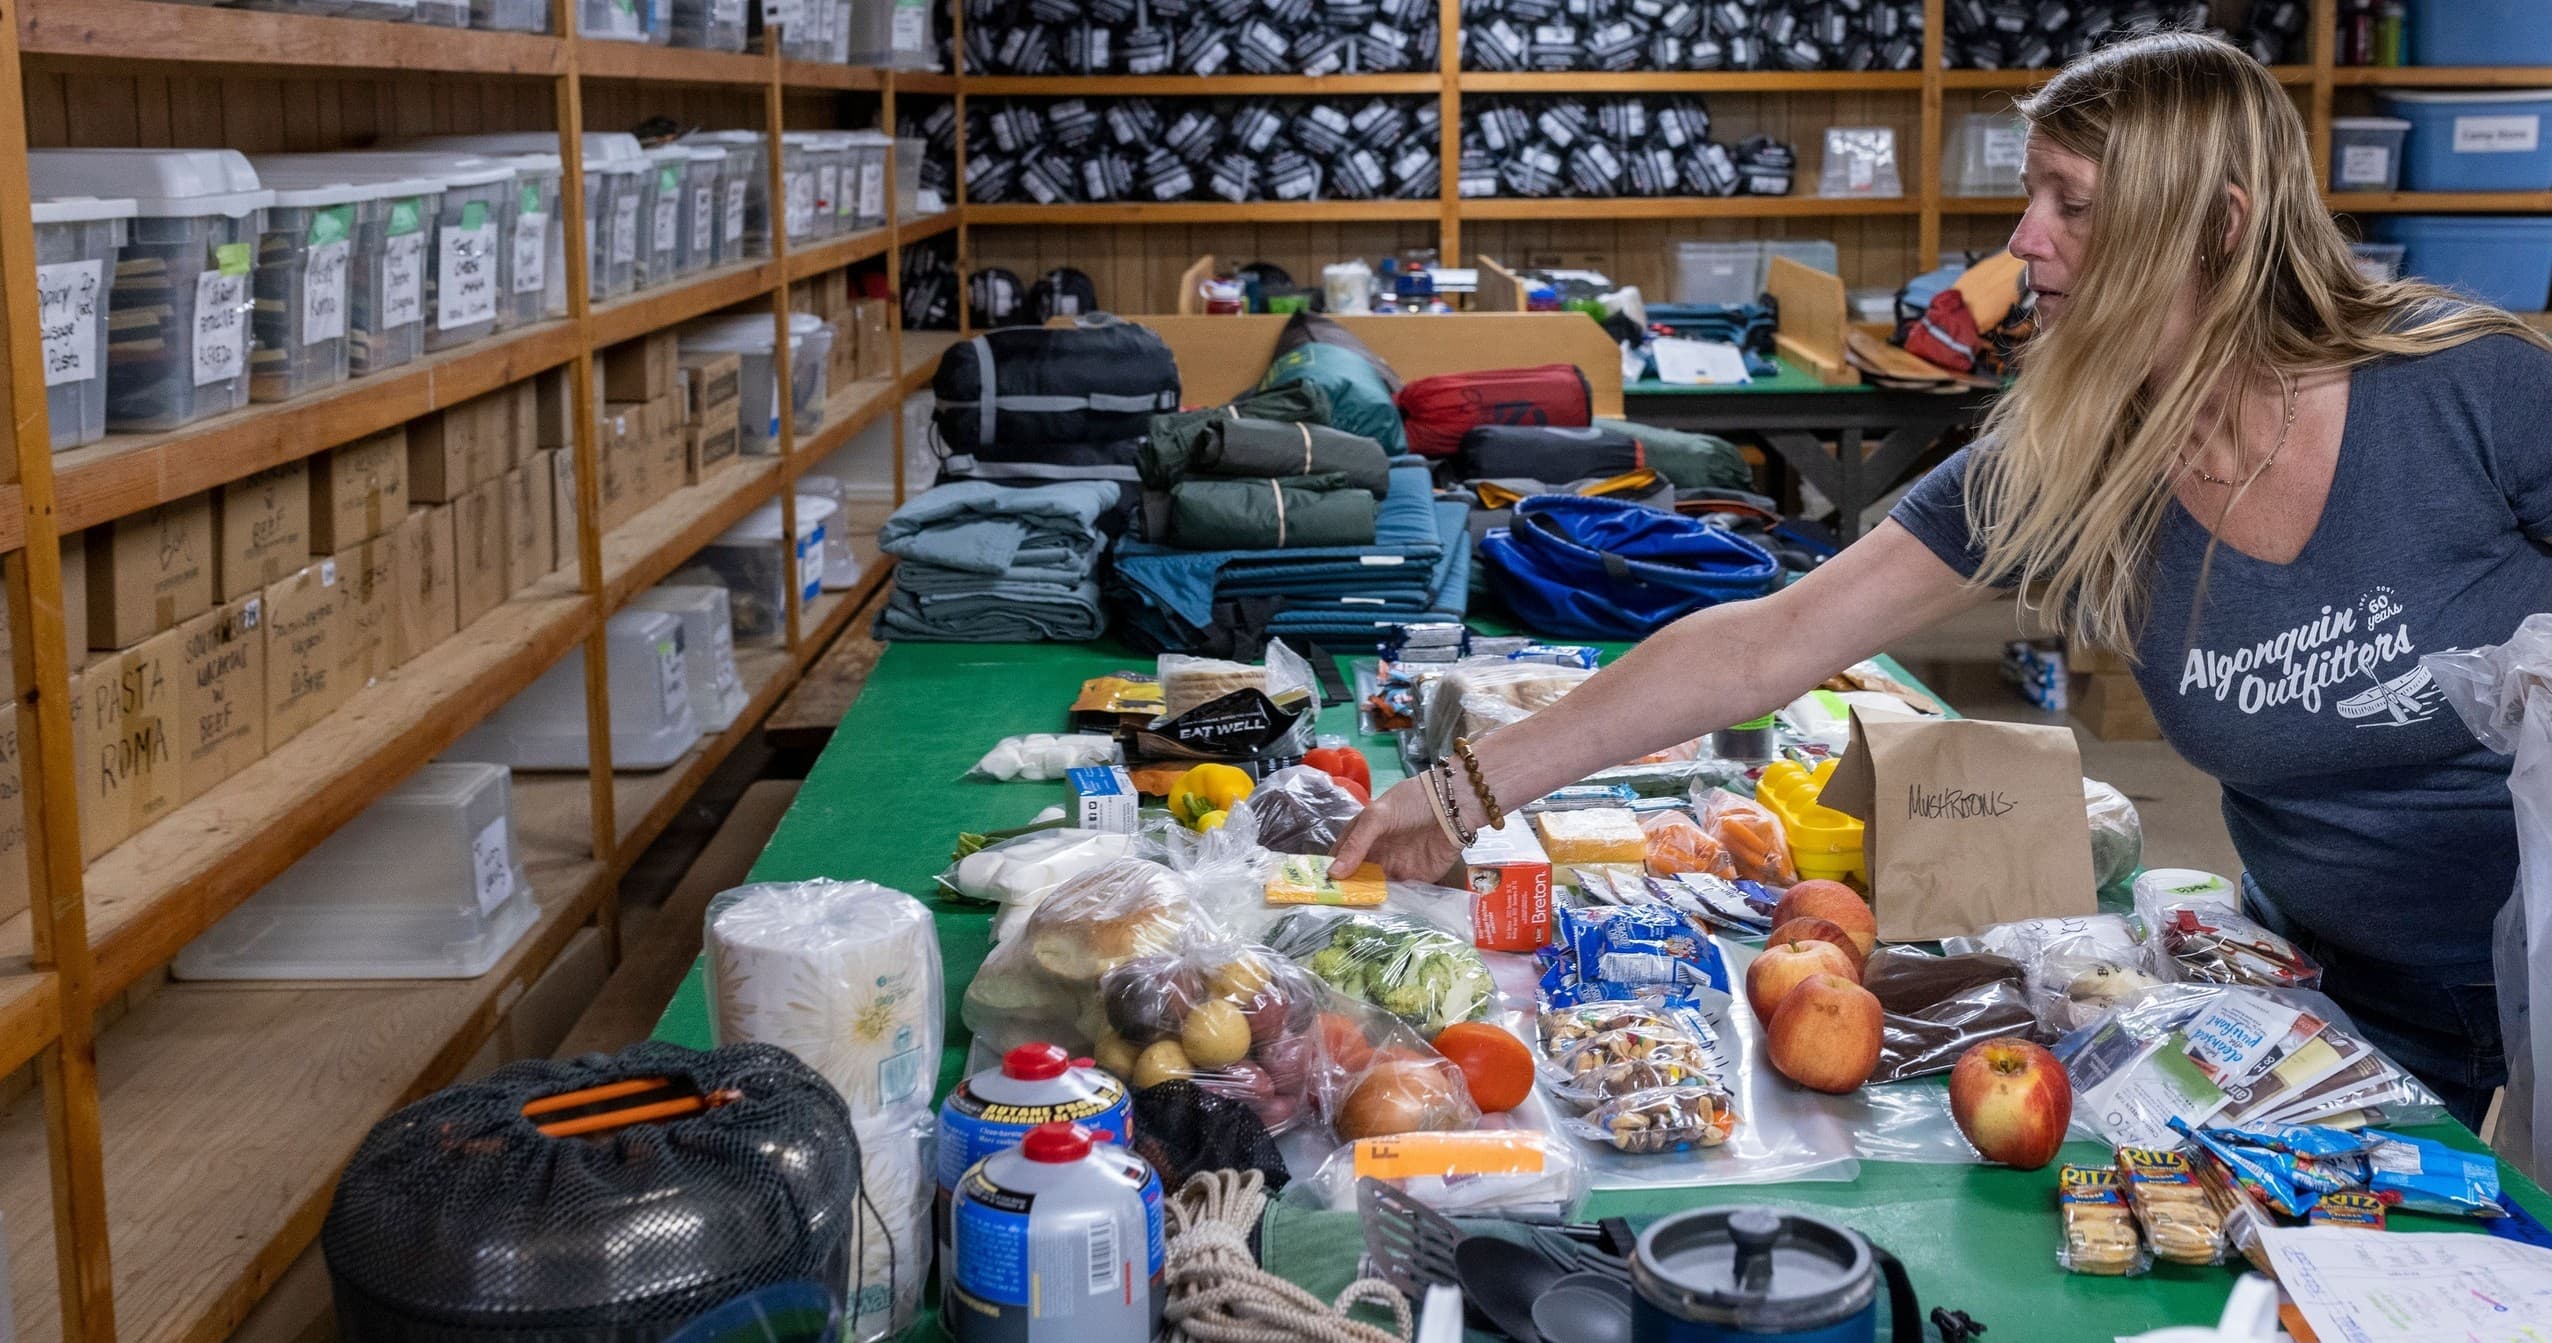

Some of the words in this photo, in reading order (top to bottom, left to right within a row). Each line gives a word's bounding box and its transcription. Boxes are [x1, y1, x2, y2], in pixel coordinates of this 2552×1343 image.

[2367, 602, 2403, 631] years
[2368, 595, 2389, 613] 60
[2179, 605, 2357, 702] Algonquin
[2238, 623, 2415, 714] Outfitters
[95, 658, 164, 731] PASTA
[200, 702, 233, 743] BEEF
[1179, 726, 1215, 740] EAT
[1216, 719, 1266, 735] WELL
[100, 717, 169, 798] ROMA
[1907, 783, 2016, 820] MUSHROOMS
[2192, 1029, 2243, 1062] cleansed
[983, 1104, 1052, 1119] BUTANE
[2124, 1148, 2184, 1170] RITZ
[2061, 1168, 2114, 1189] RITZ
